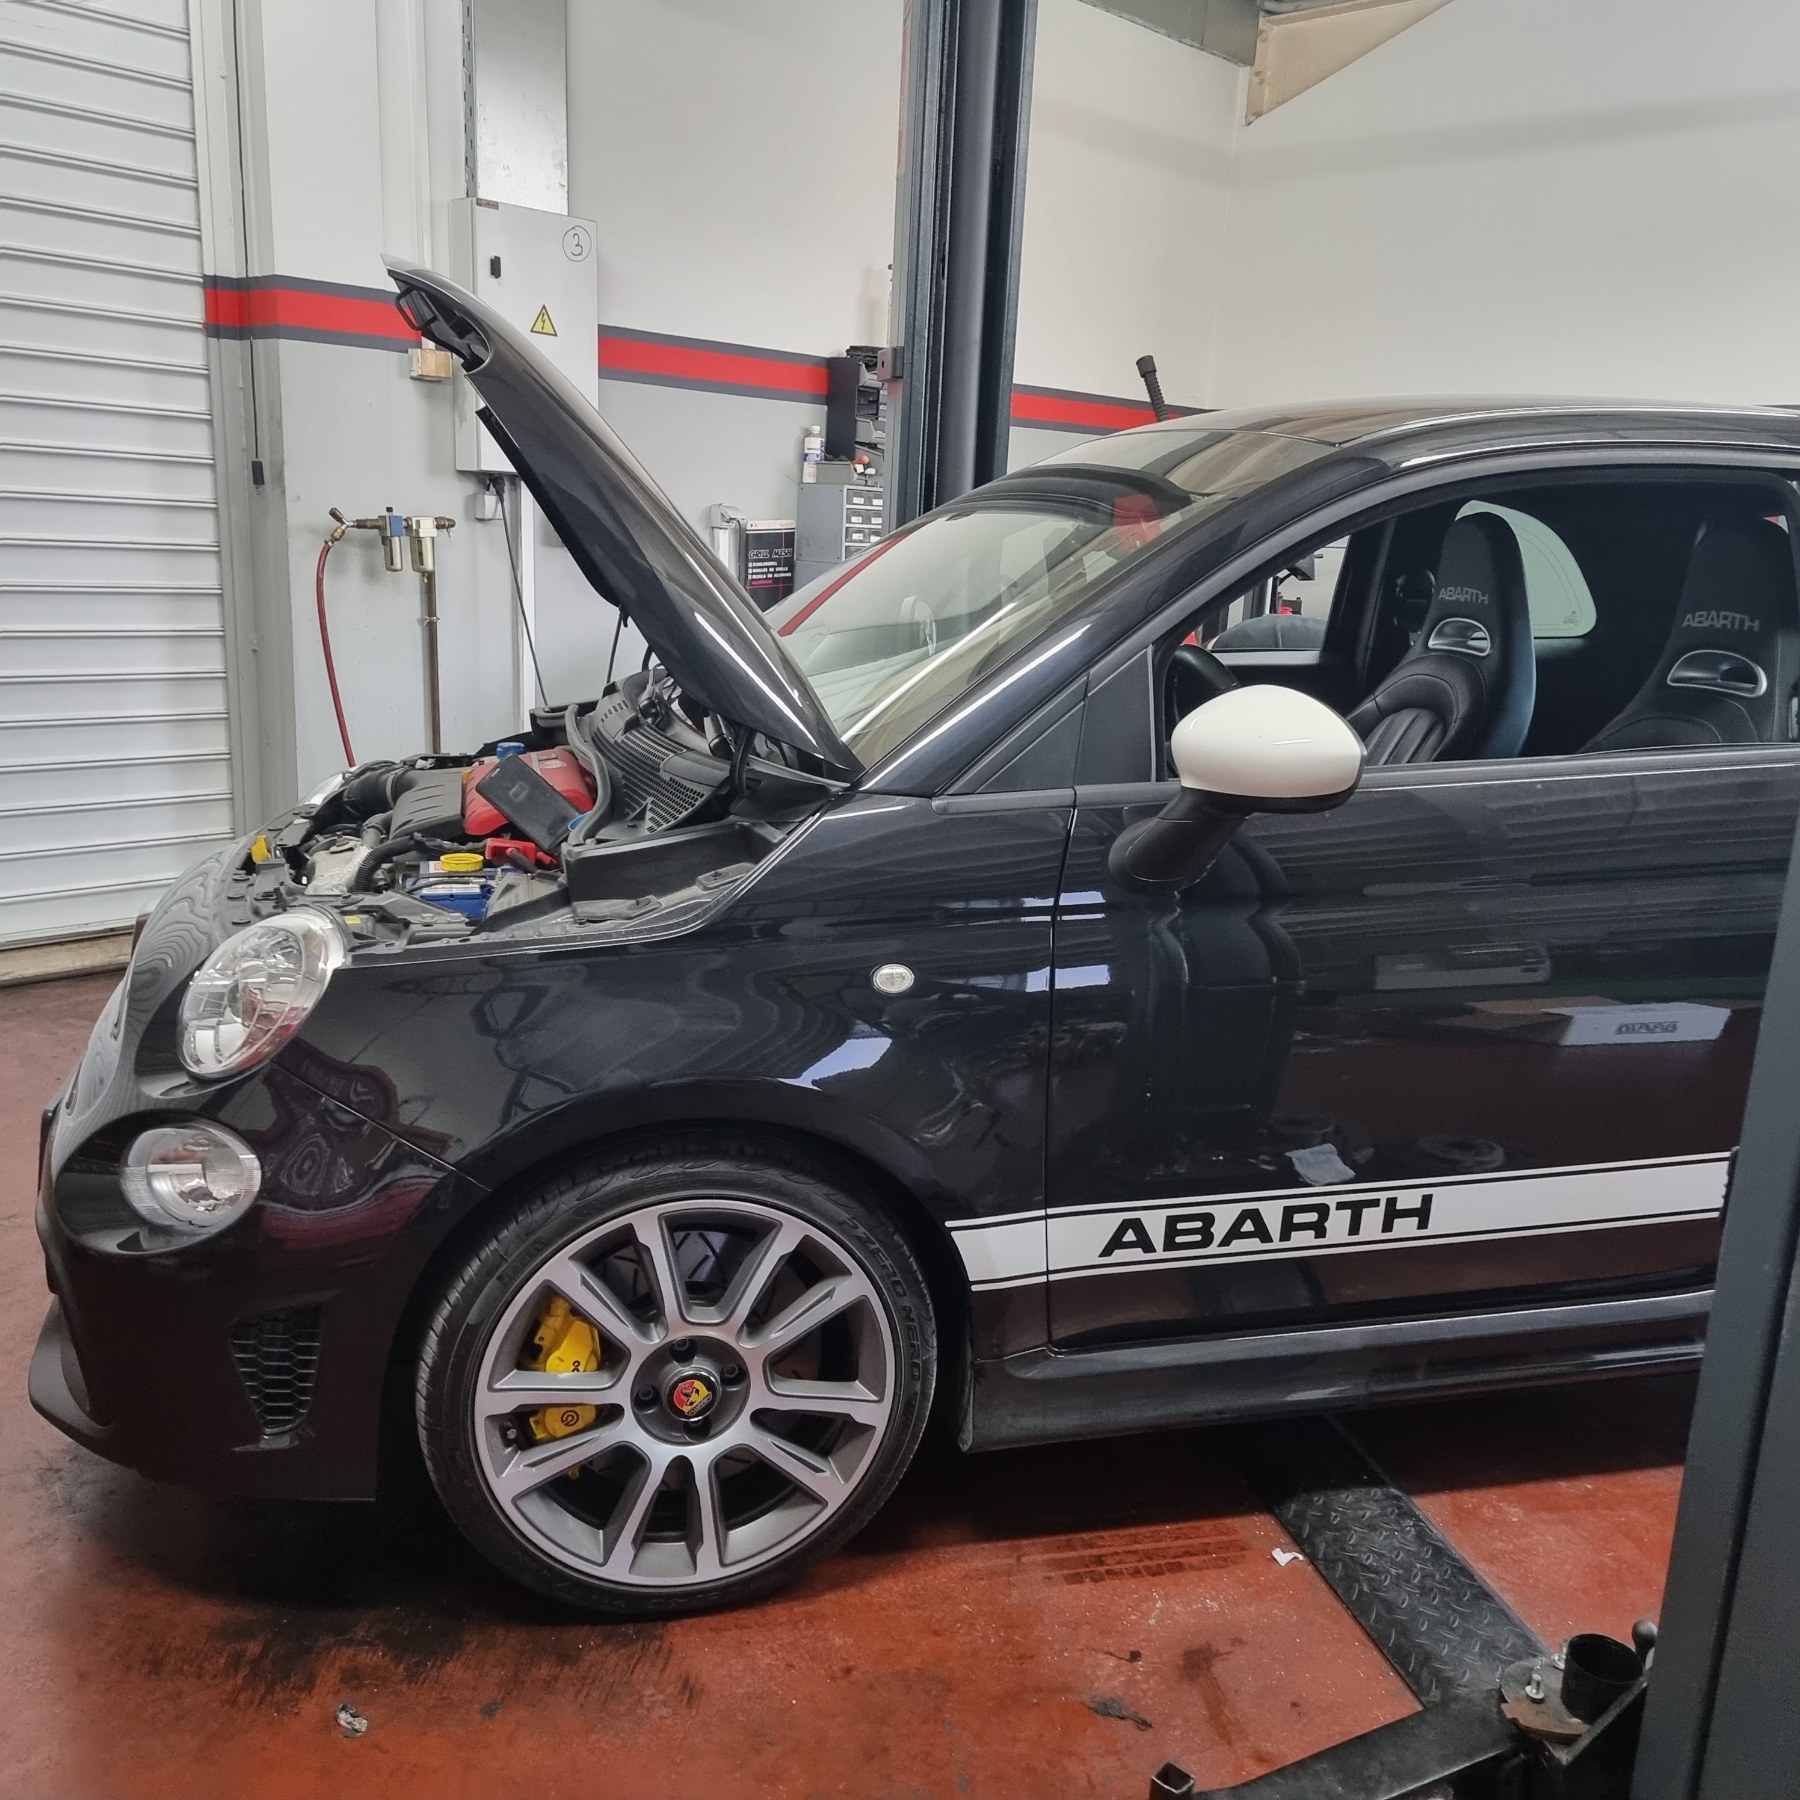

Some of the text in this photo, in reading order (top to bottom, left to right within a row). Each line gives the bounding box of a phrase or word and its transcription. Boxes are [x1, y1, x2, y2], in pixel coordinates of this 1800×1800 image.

[571, 233, 583, 256] 3
[771, 548, 792, 558] MESH
[1438, 586, 1489, 605] ABARTH
[1682, 610, 1760, 632] ABARTH
[1098, 1193, 1434, 1258] ABARTH
